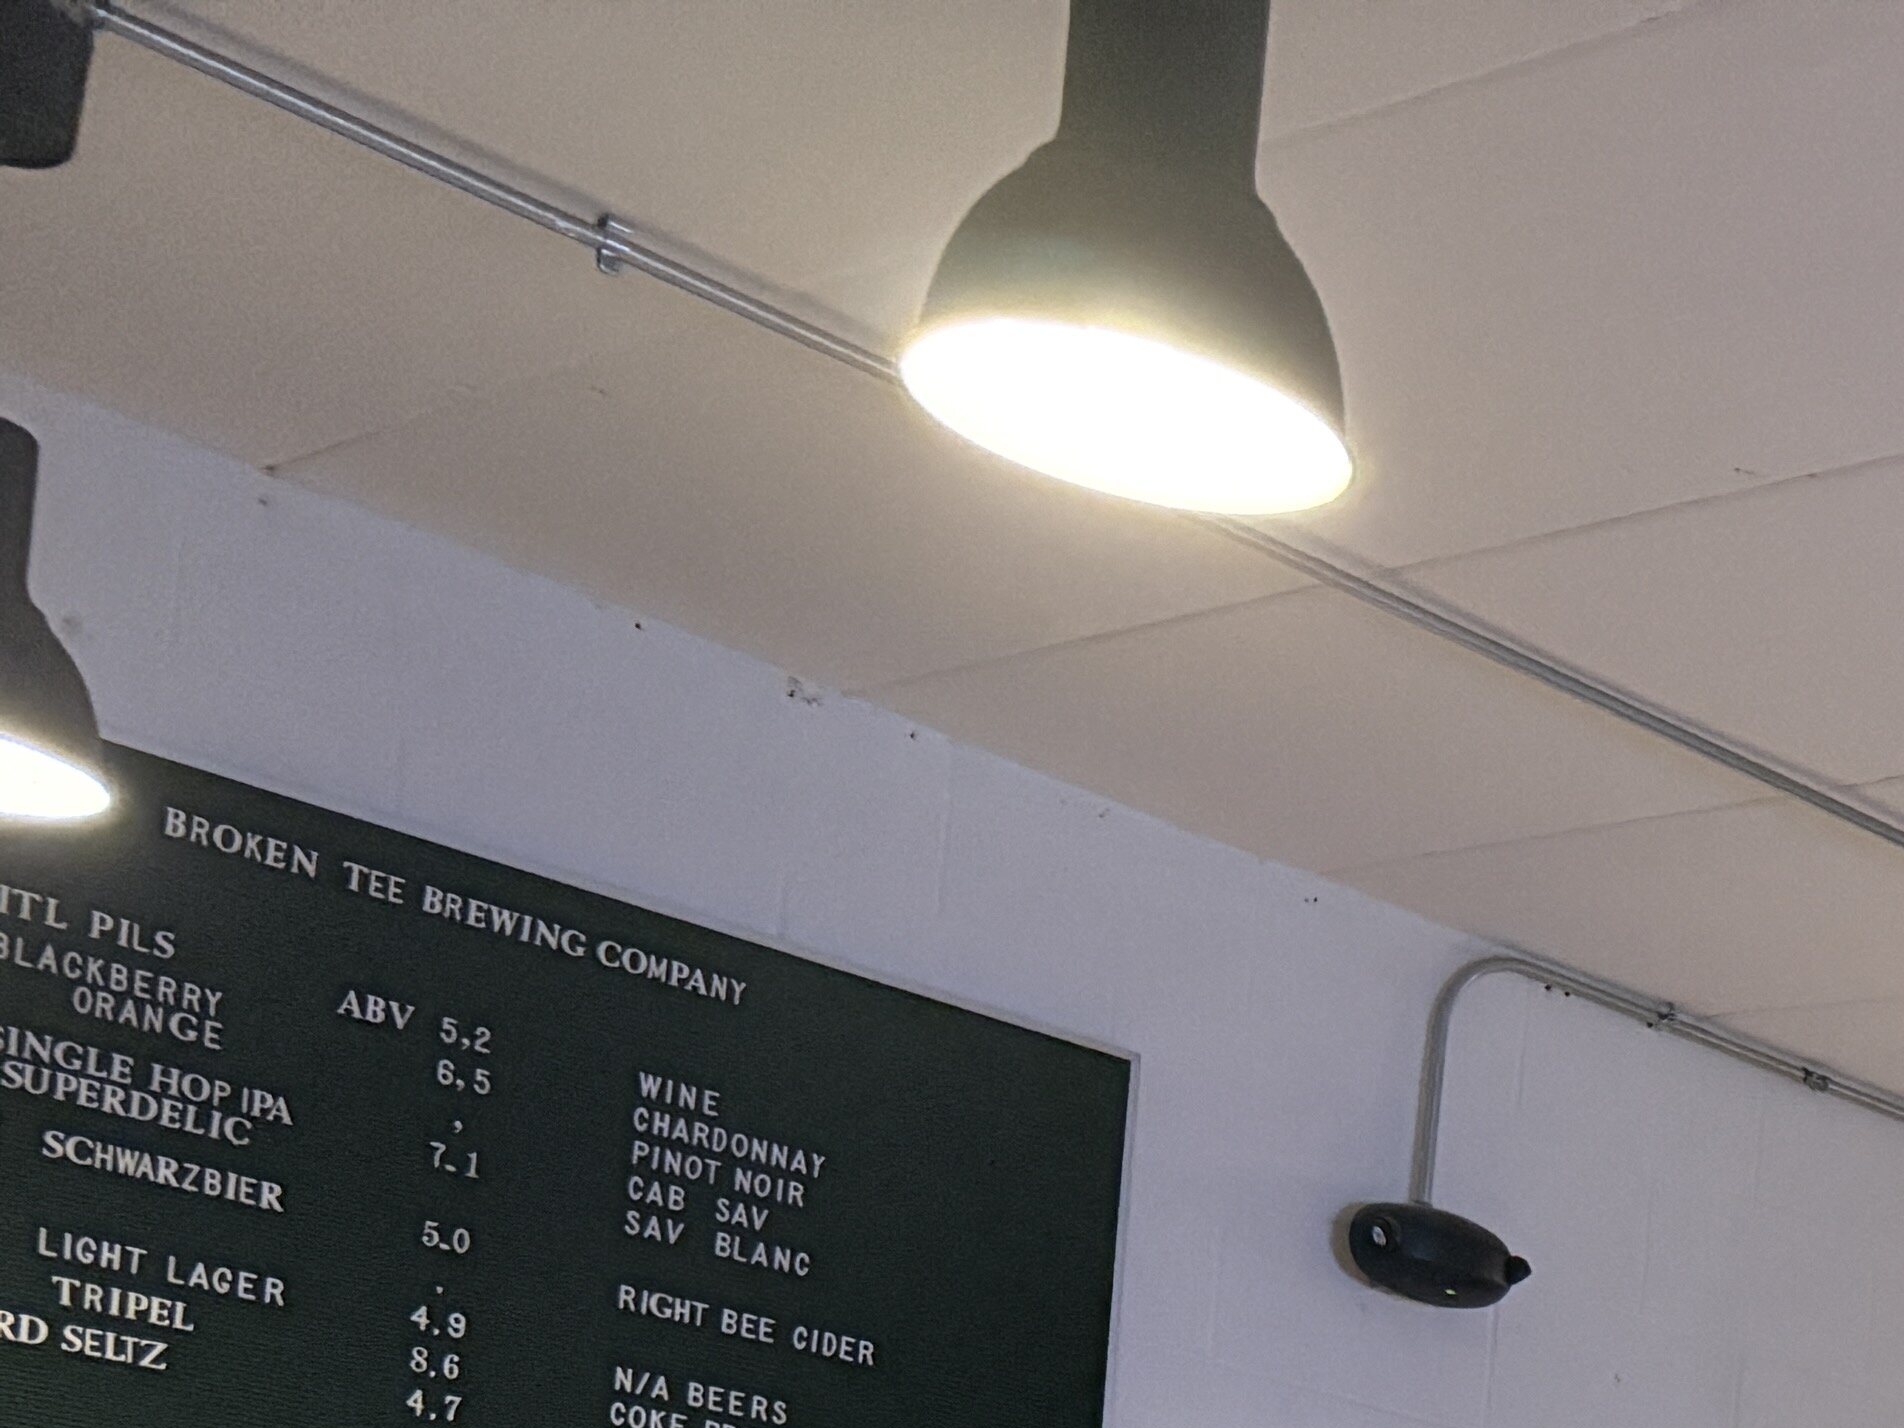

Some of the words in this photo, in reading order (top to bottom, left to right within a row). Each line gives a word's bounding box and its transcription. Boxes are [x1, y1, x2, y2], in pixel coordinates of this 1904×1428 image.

[88, 911, 177, 960] PILS
[164, 806, 320, 878] BROKEN
[343, 861, 406, 904] TEE
[422, 885, 587, 958] BREWING
[596, 940, 747, 1005] COMPANY
[0, 933, 224, 1018] BLACKBERRY
[72, 988, 224, 1051] ORANGE
[336, 990, 416, 1031] ABV
[1, 1061, 254, 1146] SUPERDELIC
[151, 1063, 232, 1107] HOP
[241, 1087, 294, 1127] IPA
[639, 1071, 721, 1117] WINE
[42, 1130, 285, 1212] SCHWARZBIER
[633, 1107, 826, 1179] CHARDONNAY
[627, 1176, 687, 1212] CAB
[715, 1199, 770, 1231] SAV
[631, 1141, 722, 1185] PINOT
[733, 1168, 806, 1208] NOIR
[37, 1227, 149, 1275] LIGHT
[166, 1254, 286, 1306] LAGER
[422, 1221, 471, 1255] 5.0
[624, 1210, 685, 1245] SAV
[714, 1232, 812, 1277] BLANC
[51, 1275, 195, 1332] TRIPEL
[409, 1305, 468, 1340] 4.9
[617, 1285, 710, 1326] RIGHT
[721, 1309, 776, 1344] BEE
[793, 1326, 876, 1366] CIDER
[61, 1325, 169, 1370] SELTZ
[409, 1346, 461, 1381] 8.6
[405, 1389, 463, 1422] 4.7
[615, 1367, 670, 1401] N/A
[687, 1382, 788, 1425] BEERS
